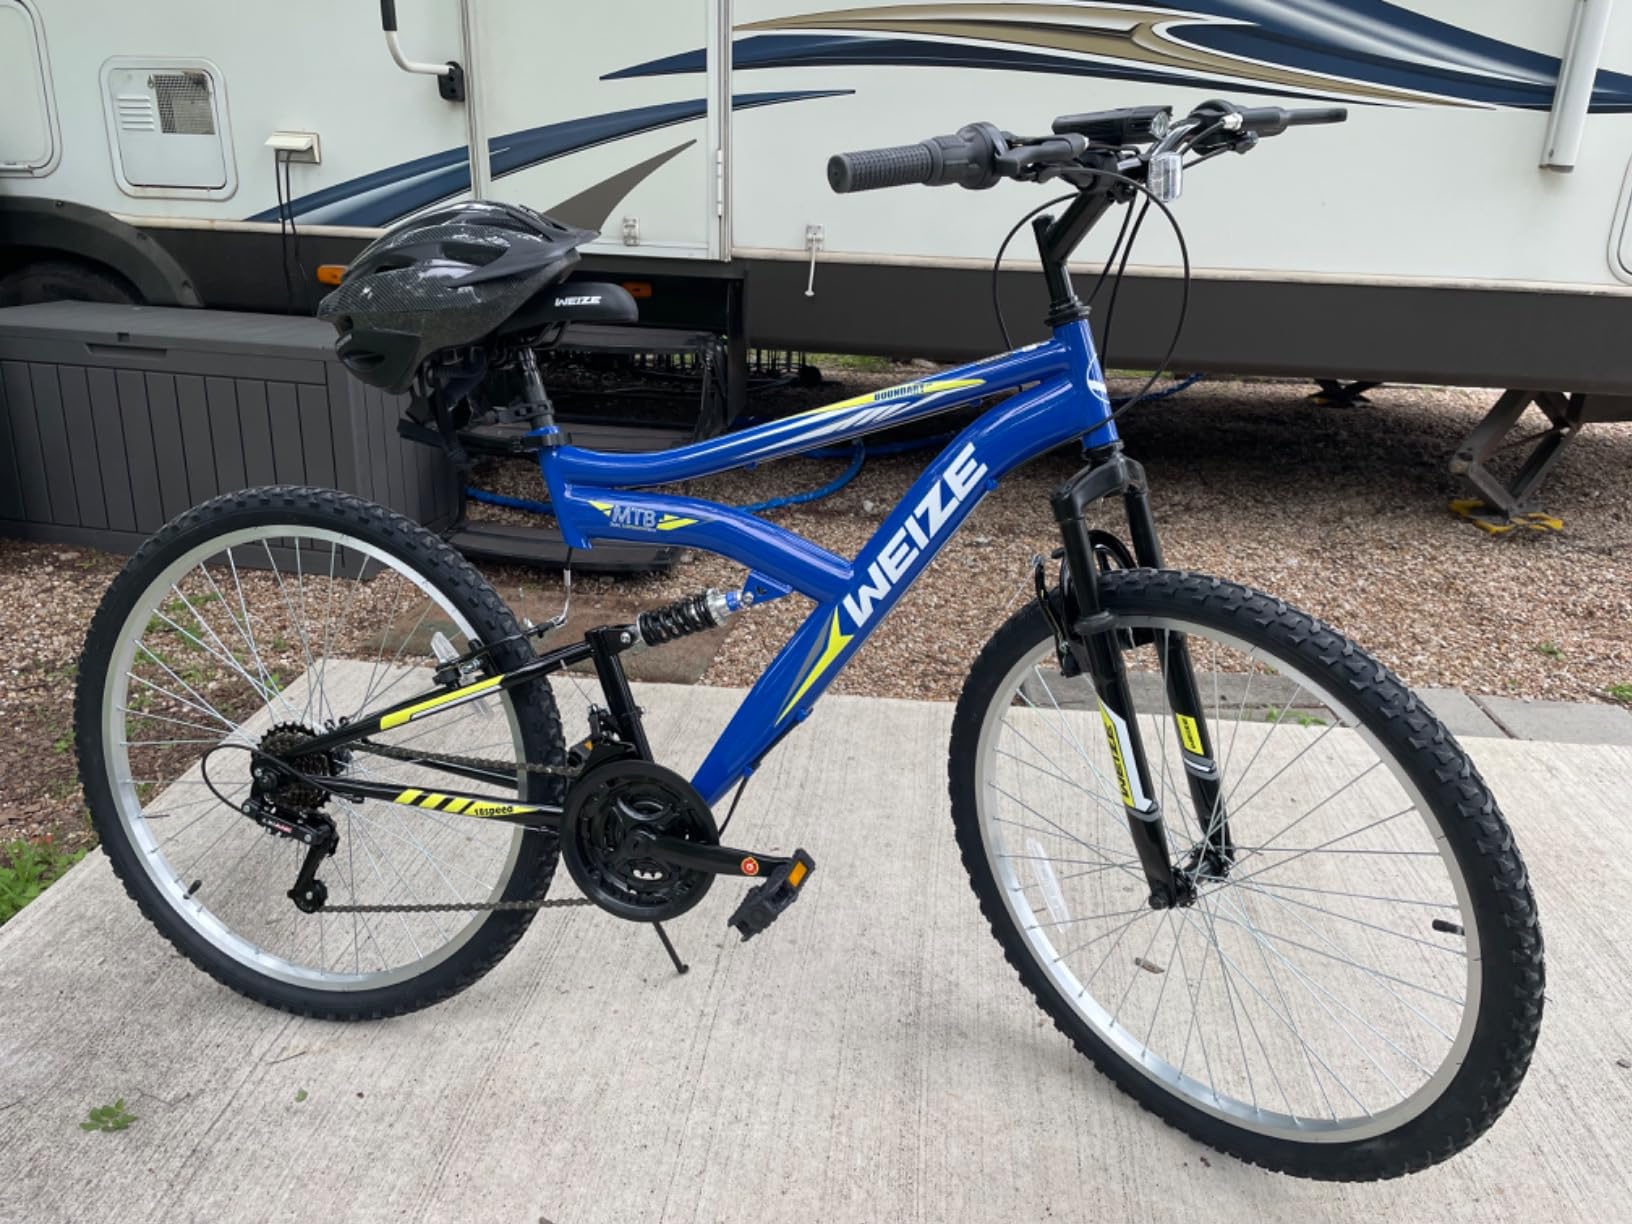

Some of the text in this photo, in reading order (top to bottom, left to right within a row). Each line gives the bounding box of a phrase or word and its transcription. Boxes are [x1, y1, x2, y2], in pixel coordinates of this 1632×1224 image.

[554, 296, 602, 307] WEIZE
[612, 504, 657, 527] MTB
[842, 441, 989, 628] WEIZE
